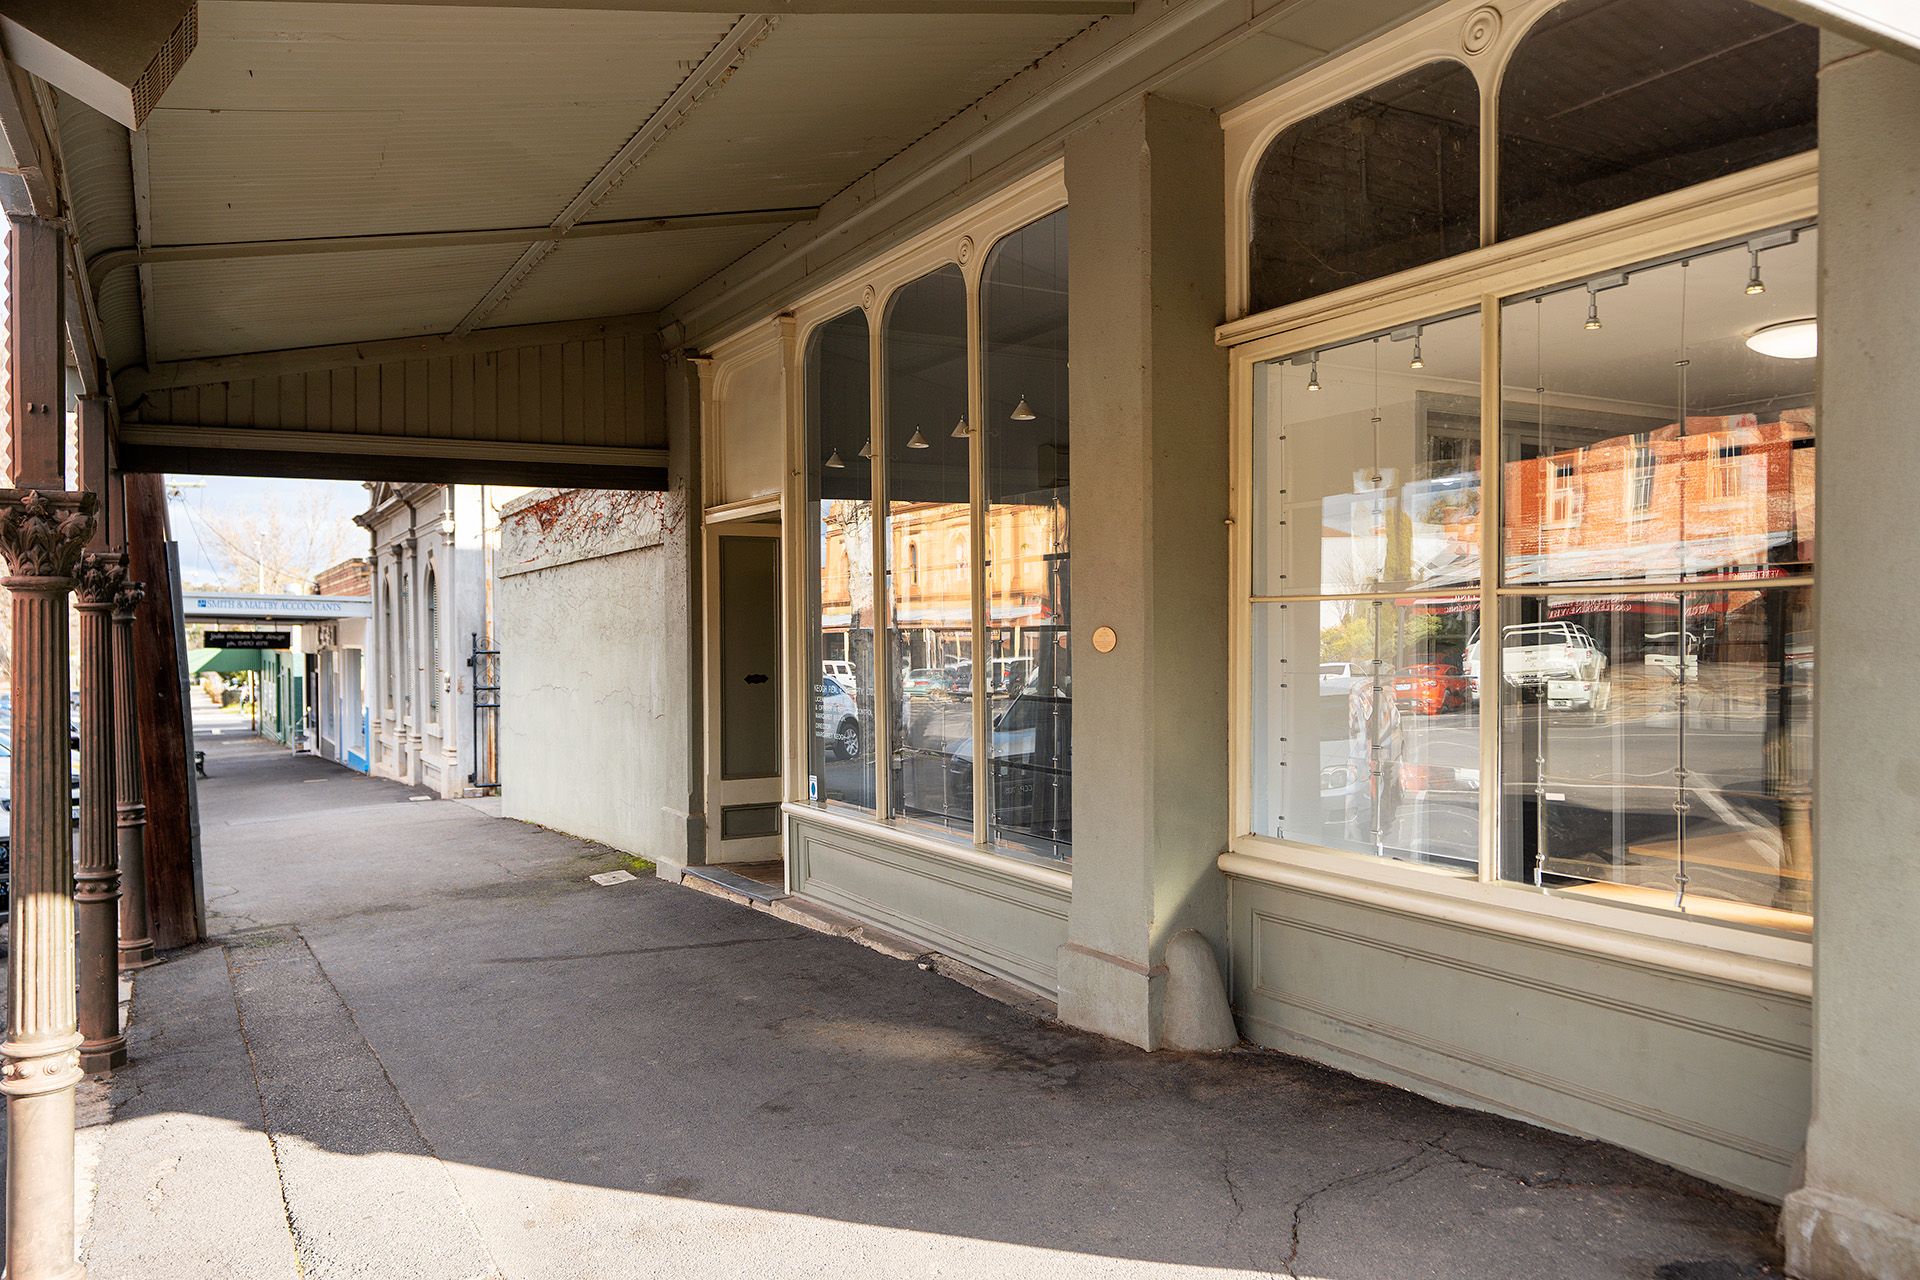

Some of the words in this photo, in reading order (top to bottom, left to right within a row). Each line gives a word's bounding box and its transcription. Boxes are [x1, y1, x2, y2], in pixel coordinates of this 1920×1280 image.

[207, 600, 234, 608] SMITH
[238, 600, 243, 608] &
[245, 600, 278, 610] MALTBY
[281, 601, 342, 611] ACCOUNTANTS
